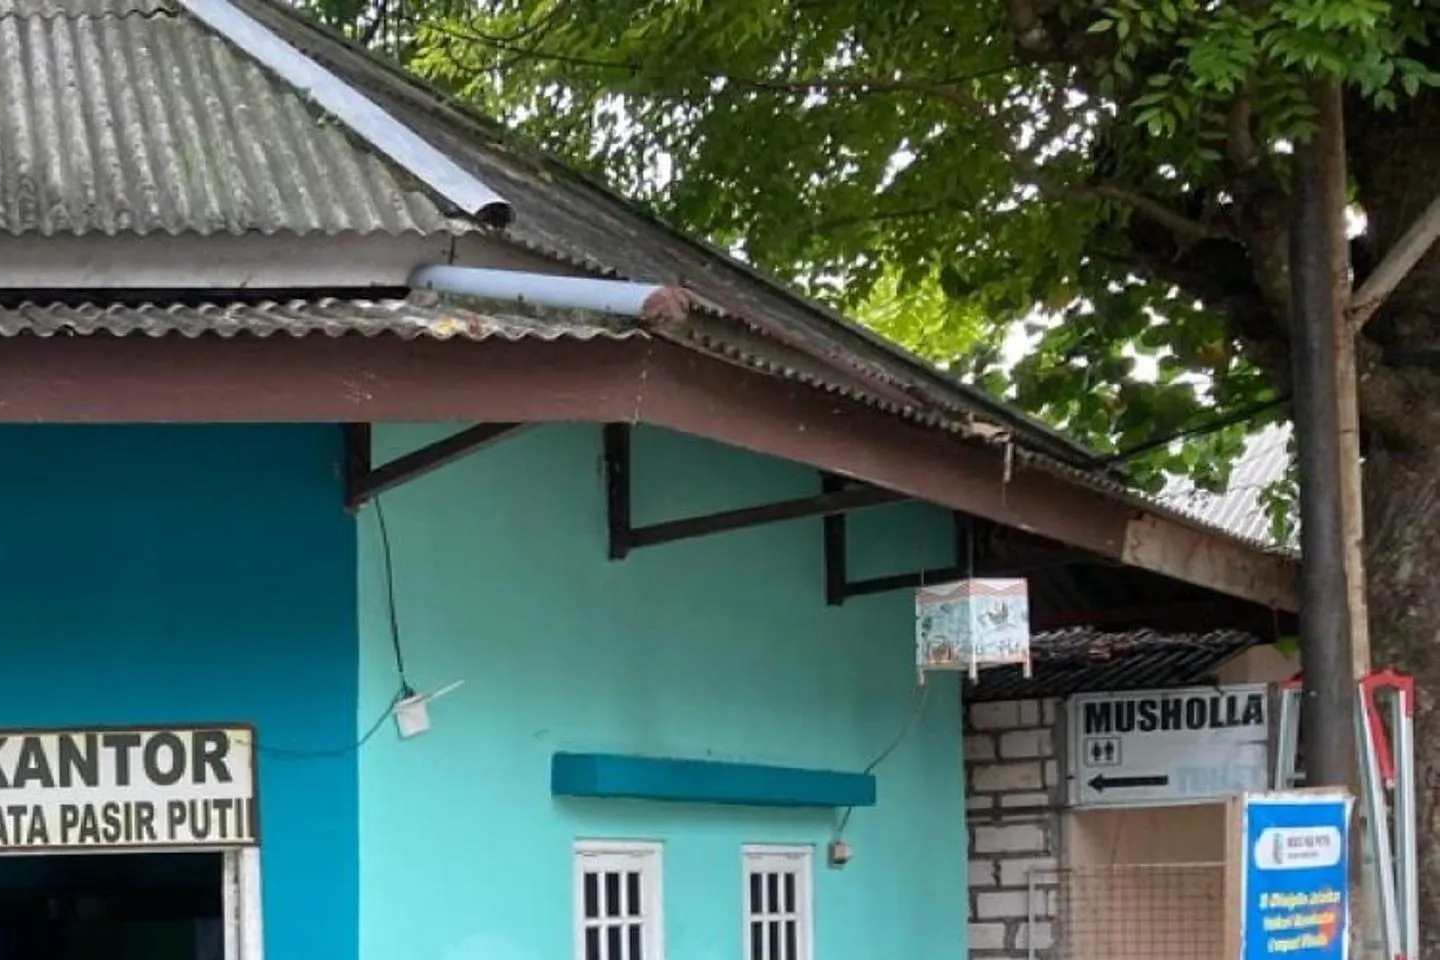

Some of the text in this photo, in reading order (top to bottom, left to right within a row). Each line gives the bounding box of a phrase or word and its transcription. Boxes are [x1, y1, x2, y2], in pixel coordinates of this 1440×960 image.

[1084, 694, 1262, 734] MUSHOLLA
[61, 800, 157, 843] PASIR
[167, 798, 254, 840] PUTI
